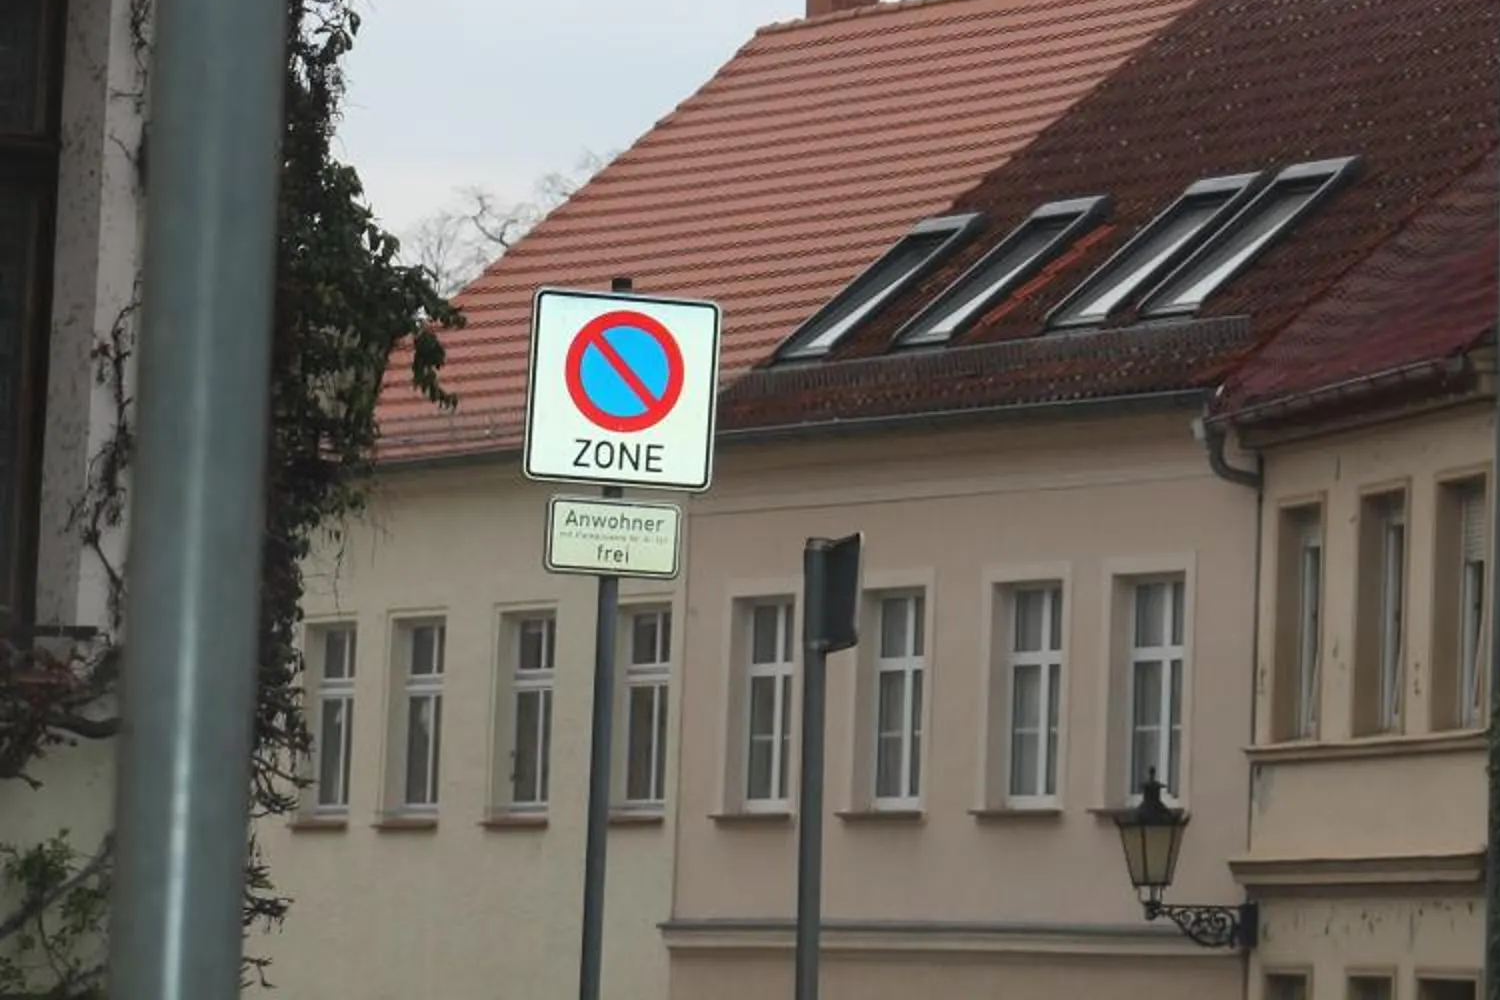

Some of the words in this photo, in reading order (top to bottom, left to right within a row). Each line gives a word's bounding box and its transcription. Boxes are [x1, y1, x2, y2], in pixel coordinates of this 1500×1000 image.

[573, 439, 664, 473] ZONE
[564, 509, 665, 532] Anwohner
[597, 543, 629, 565] frei
